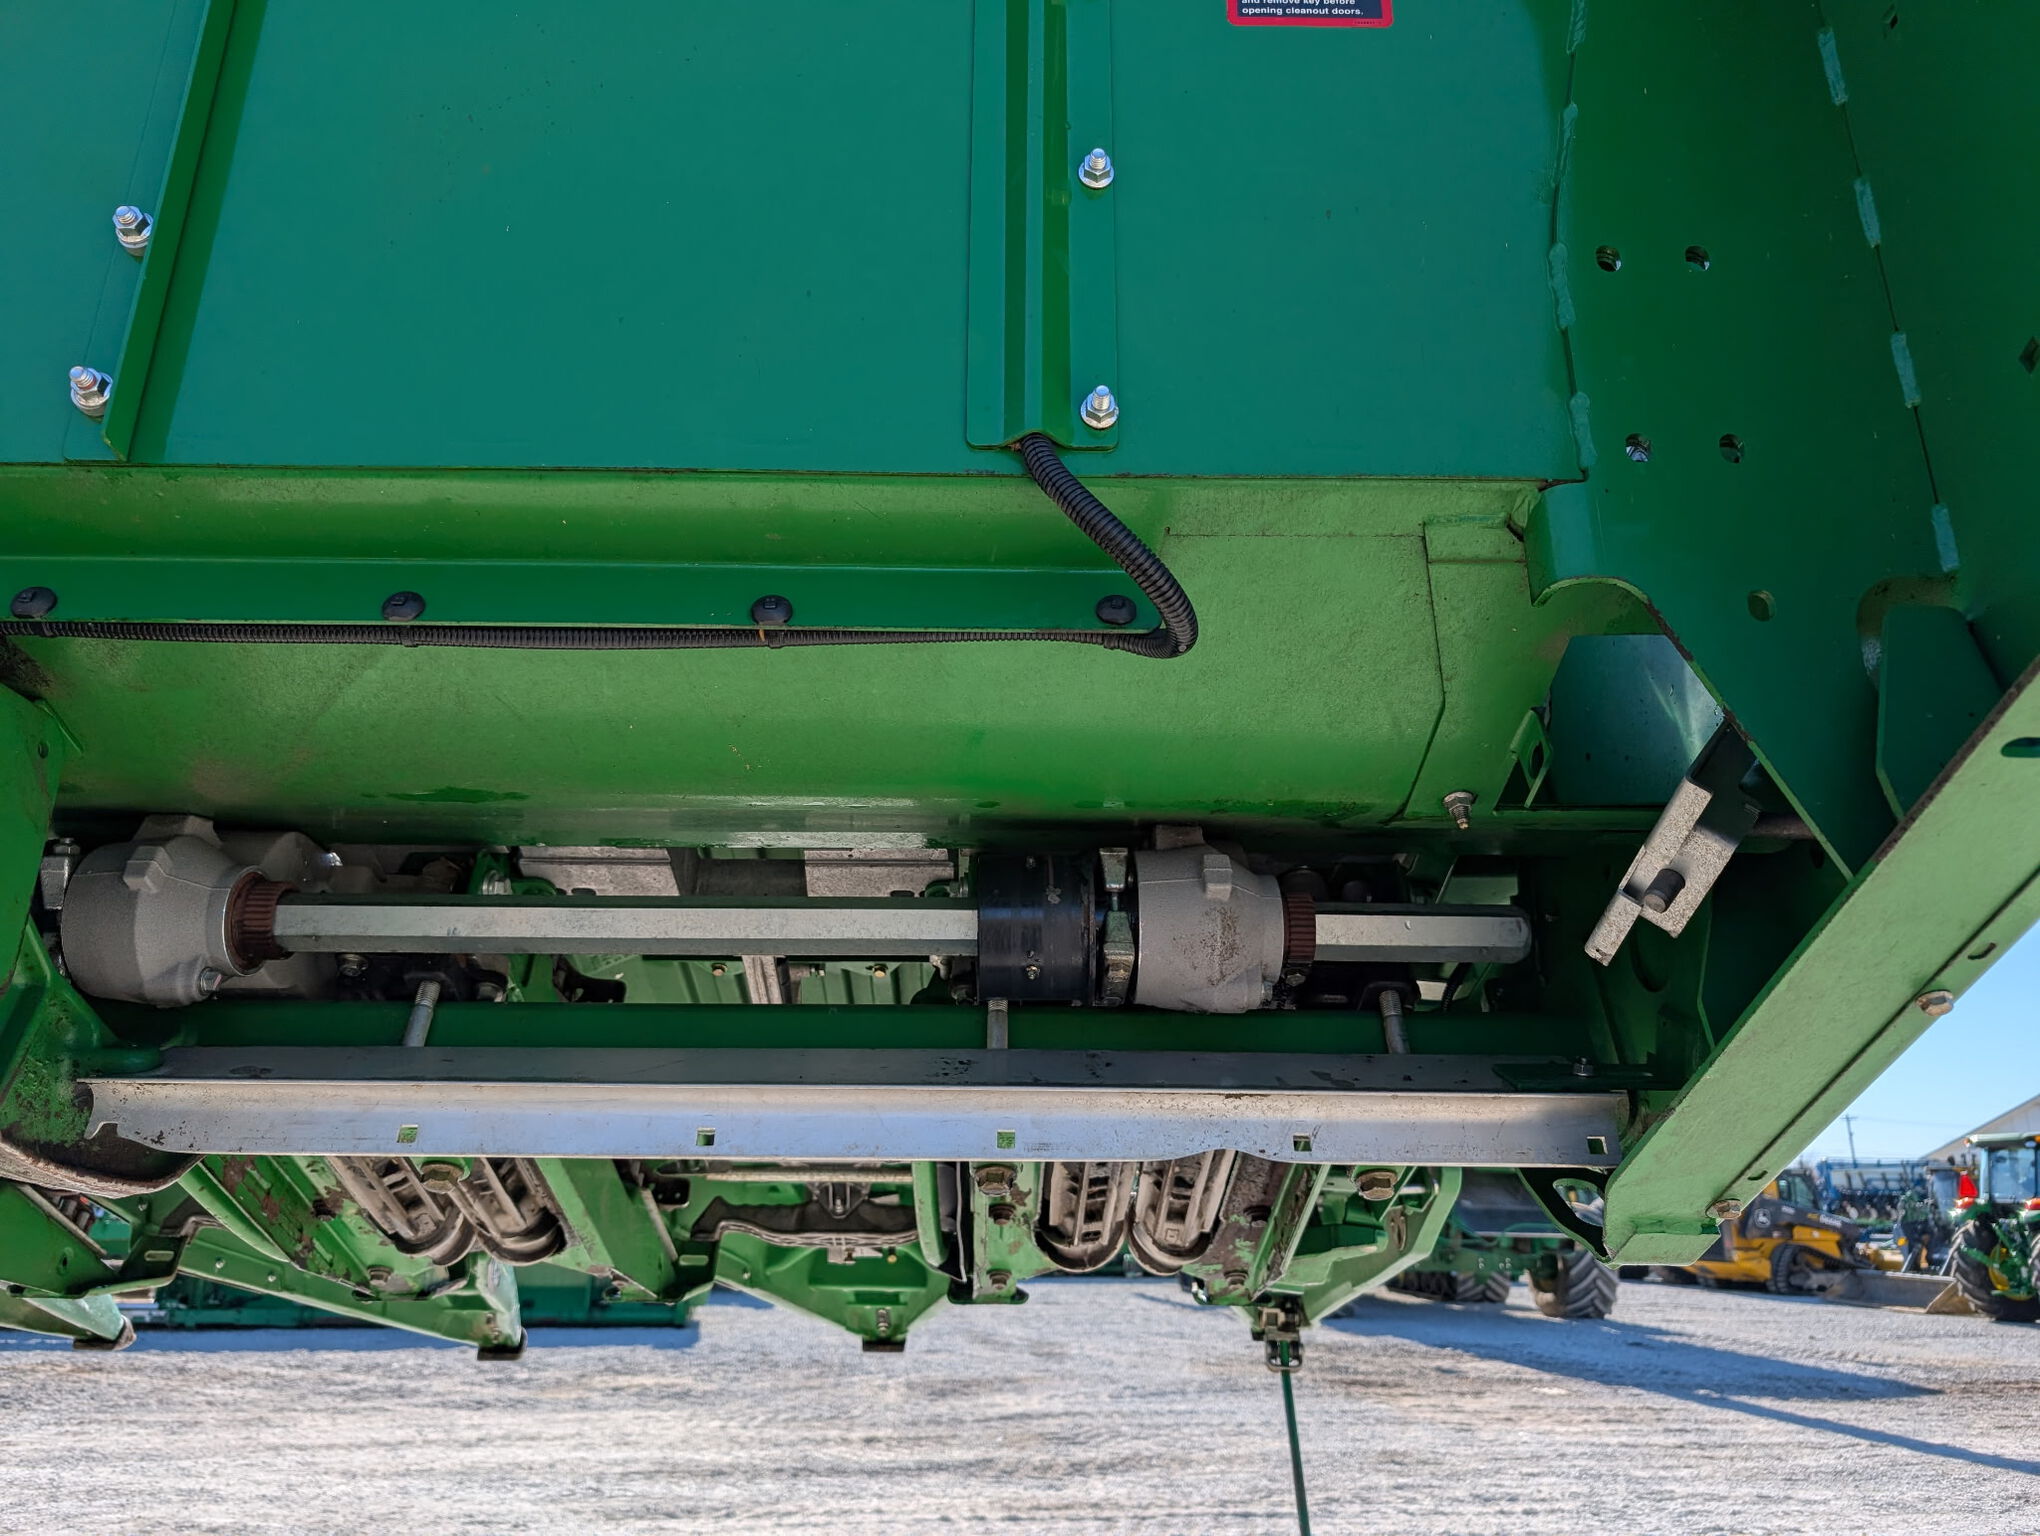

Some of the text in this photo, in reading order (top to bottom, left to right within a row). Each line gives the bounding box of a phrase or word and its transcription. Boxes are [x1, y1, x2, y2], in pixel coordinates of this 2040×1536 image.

[1241, 7, 1364, 15] opening cleanout doors.
